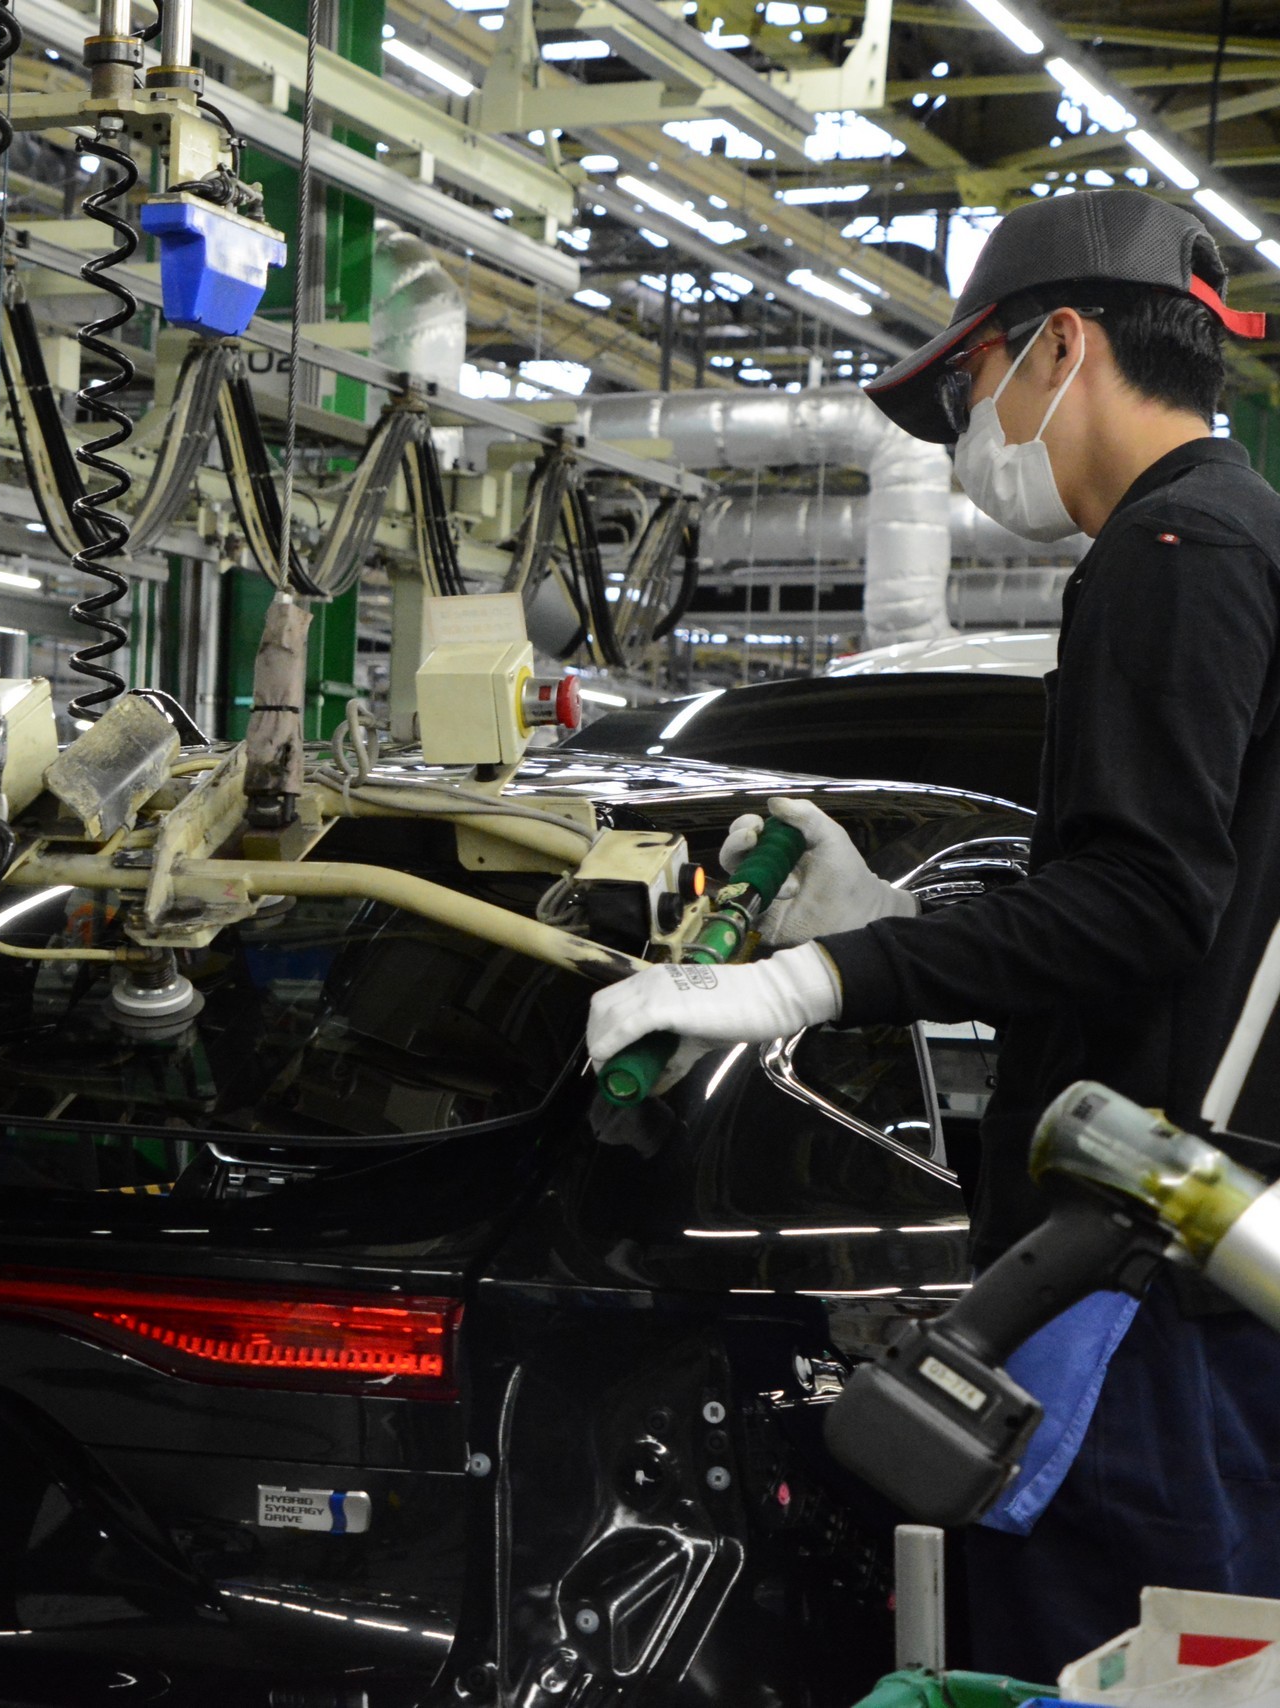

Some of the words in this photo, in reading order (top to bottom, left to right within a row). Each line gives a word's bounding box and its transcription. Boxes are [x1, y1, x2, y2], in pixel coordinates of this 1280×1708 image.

[265, 1494, 314, 1506] HYBRID
[264, 1503, 325, 1516] SYNERGY
[264, 1513, 303, 1524] DRIVE
